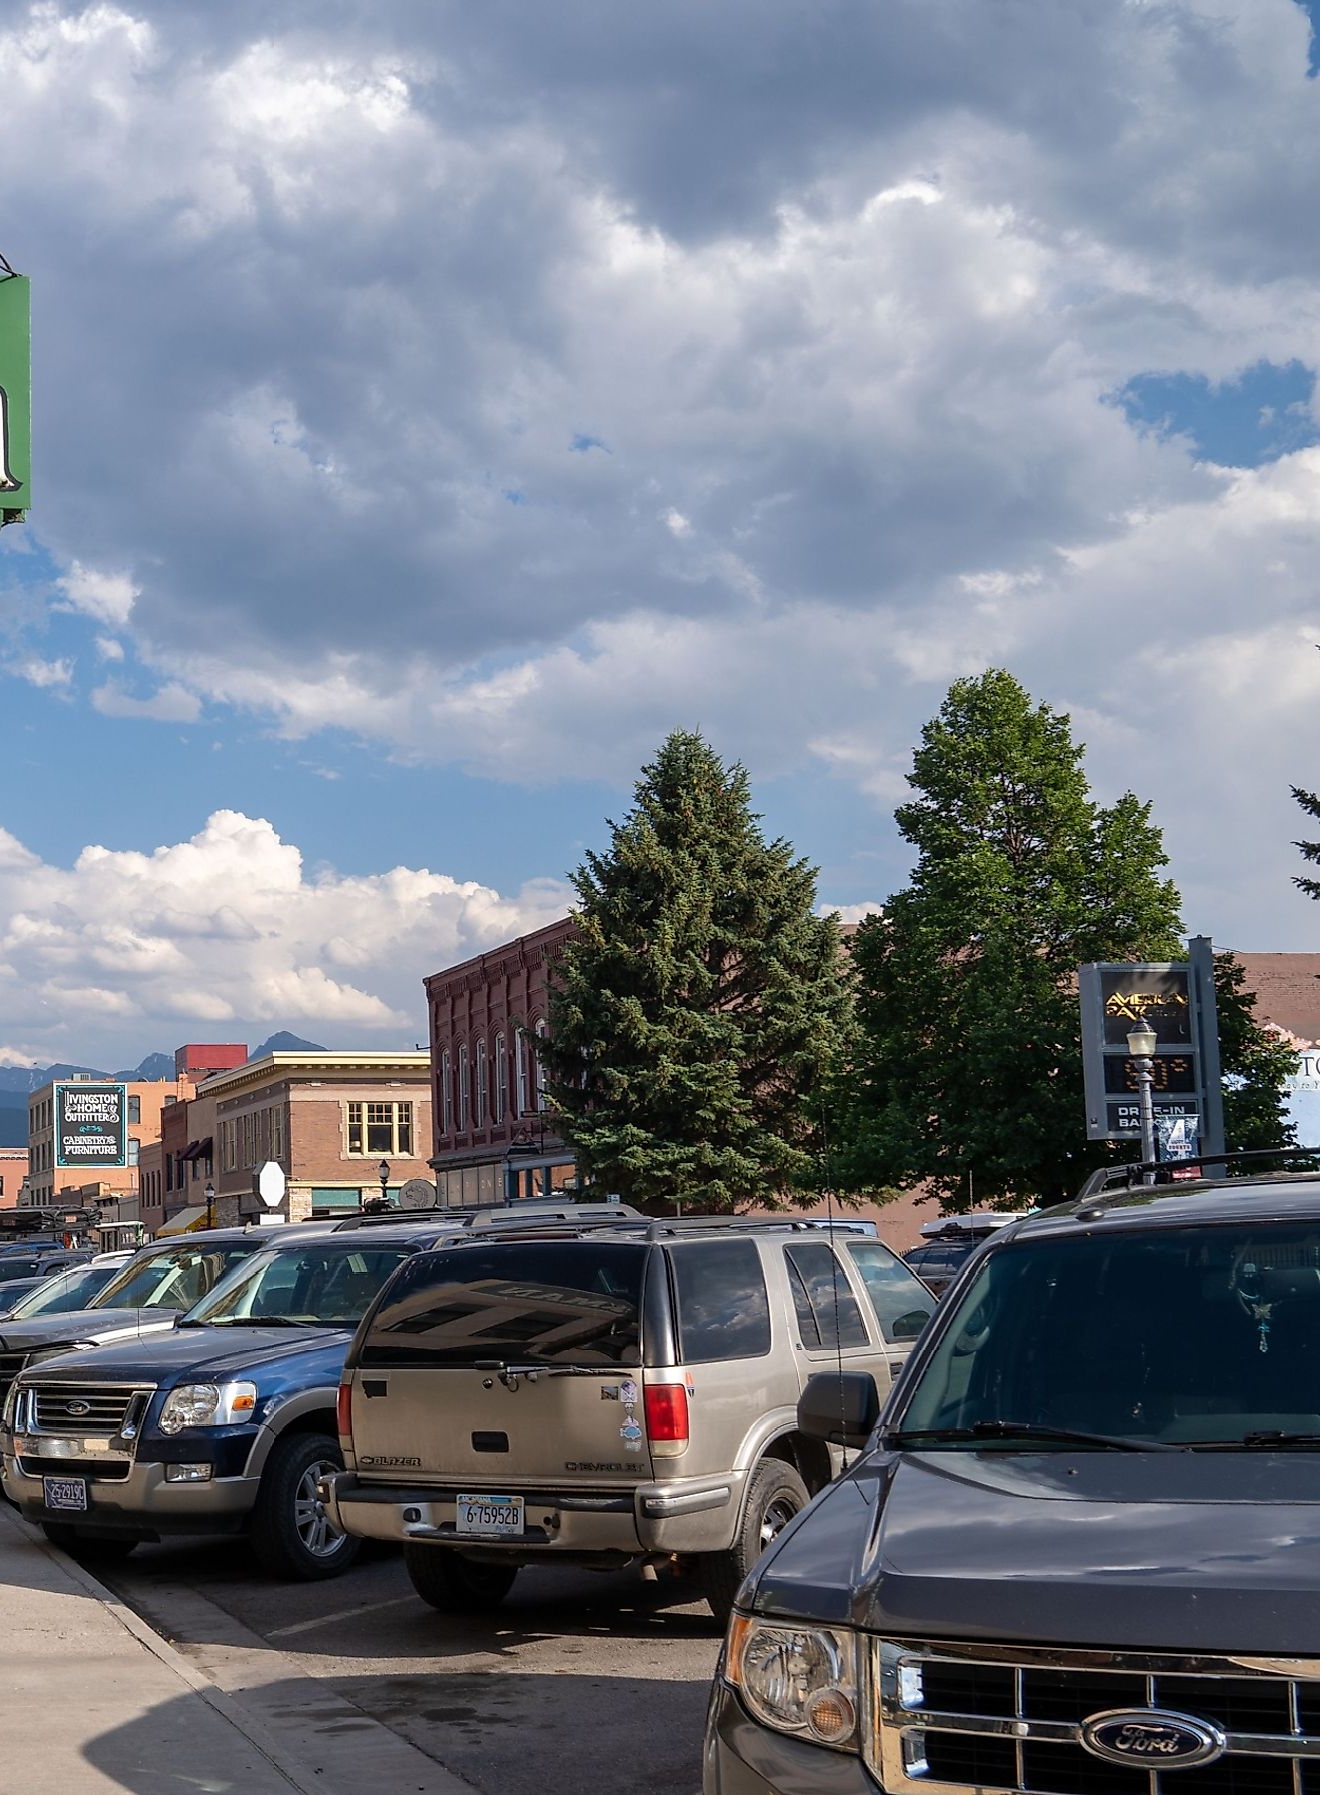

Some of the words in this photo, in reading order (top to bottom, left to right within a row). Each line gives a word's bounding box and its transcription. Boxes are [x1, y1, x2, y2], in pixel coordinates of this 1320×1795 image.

[65, 1091, 118, 1106] LIVINGSTON
[77, 1104, 108, 1112] HOME
[1118, 1107, 1185, 1115] DRE-IN
[63, 1136, 106, 1145] CABINETRY
[65, 1146, 117, 1155] FURNITURE
[373, 1456, 421, 1466] BLAZER
[1115, 1724, 1180, 1753] Ford
